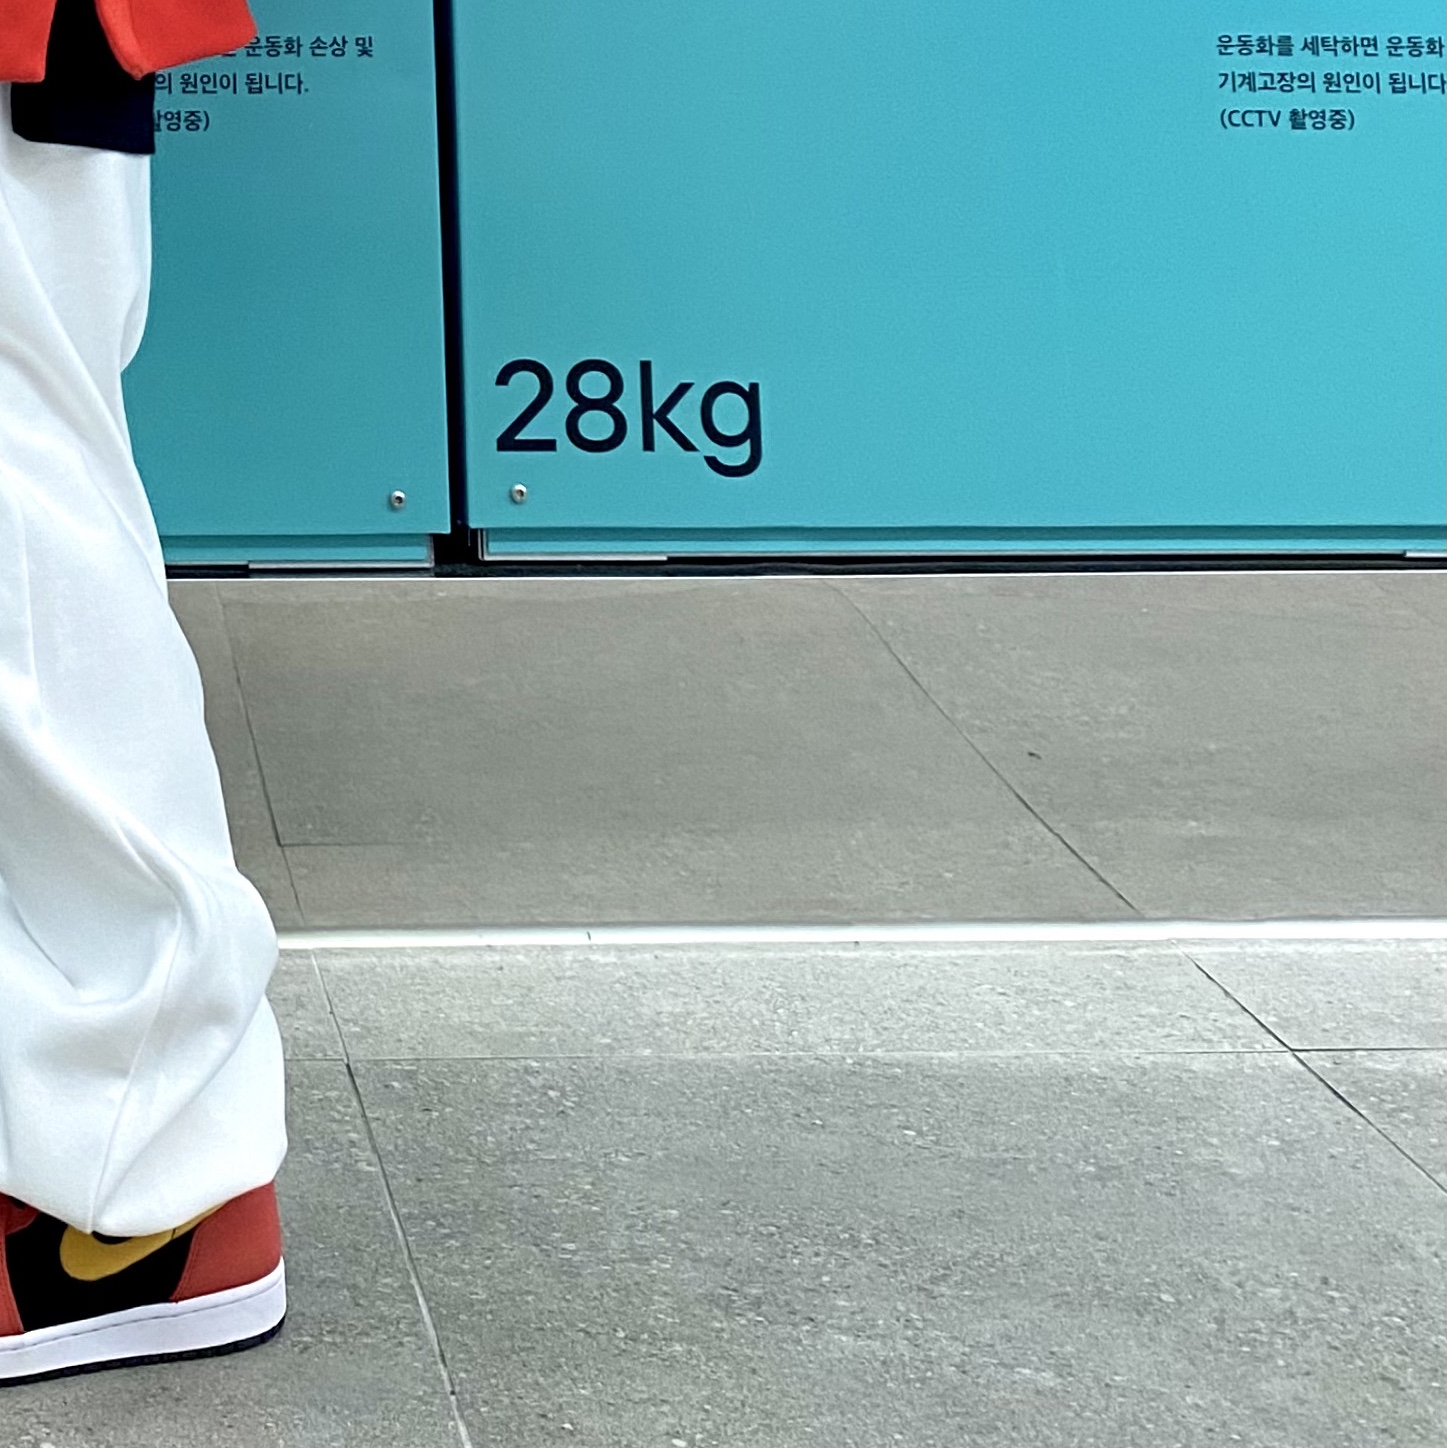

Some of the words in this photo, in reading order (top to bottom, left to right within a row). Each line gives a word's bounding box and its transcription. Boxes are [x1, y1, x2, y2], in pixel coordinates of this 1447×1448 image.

[244, 36, 303, 57] 운동화
[309, 36, 348, 57] 손상
[355, 36, 374, 57] 및
[1216, 34, 1295, 56] 운동화를
[1301, 35, 1379, 57] 세탁하면
[1386, 36, 1445, 58] 운동화
[180, 72, 237, 94] 원인이
[245, 72, 309, 94] 됩니다.
[1219, 71, 1316, 93] 기계고장의
[1322, 72, 1380, 94] 원인이
[1220, 109, 1281, 130] (CCTV
[1289, 109, 1356, 130] 촬영중)
[495, 359, 763, 478] 28kg
